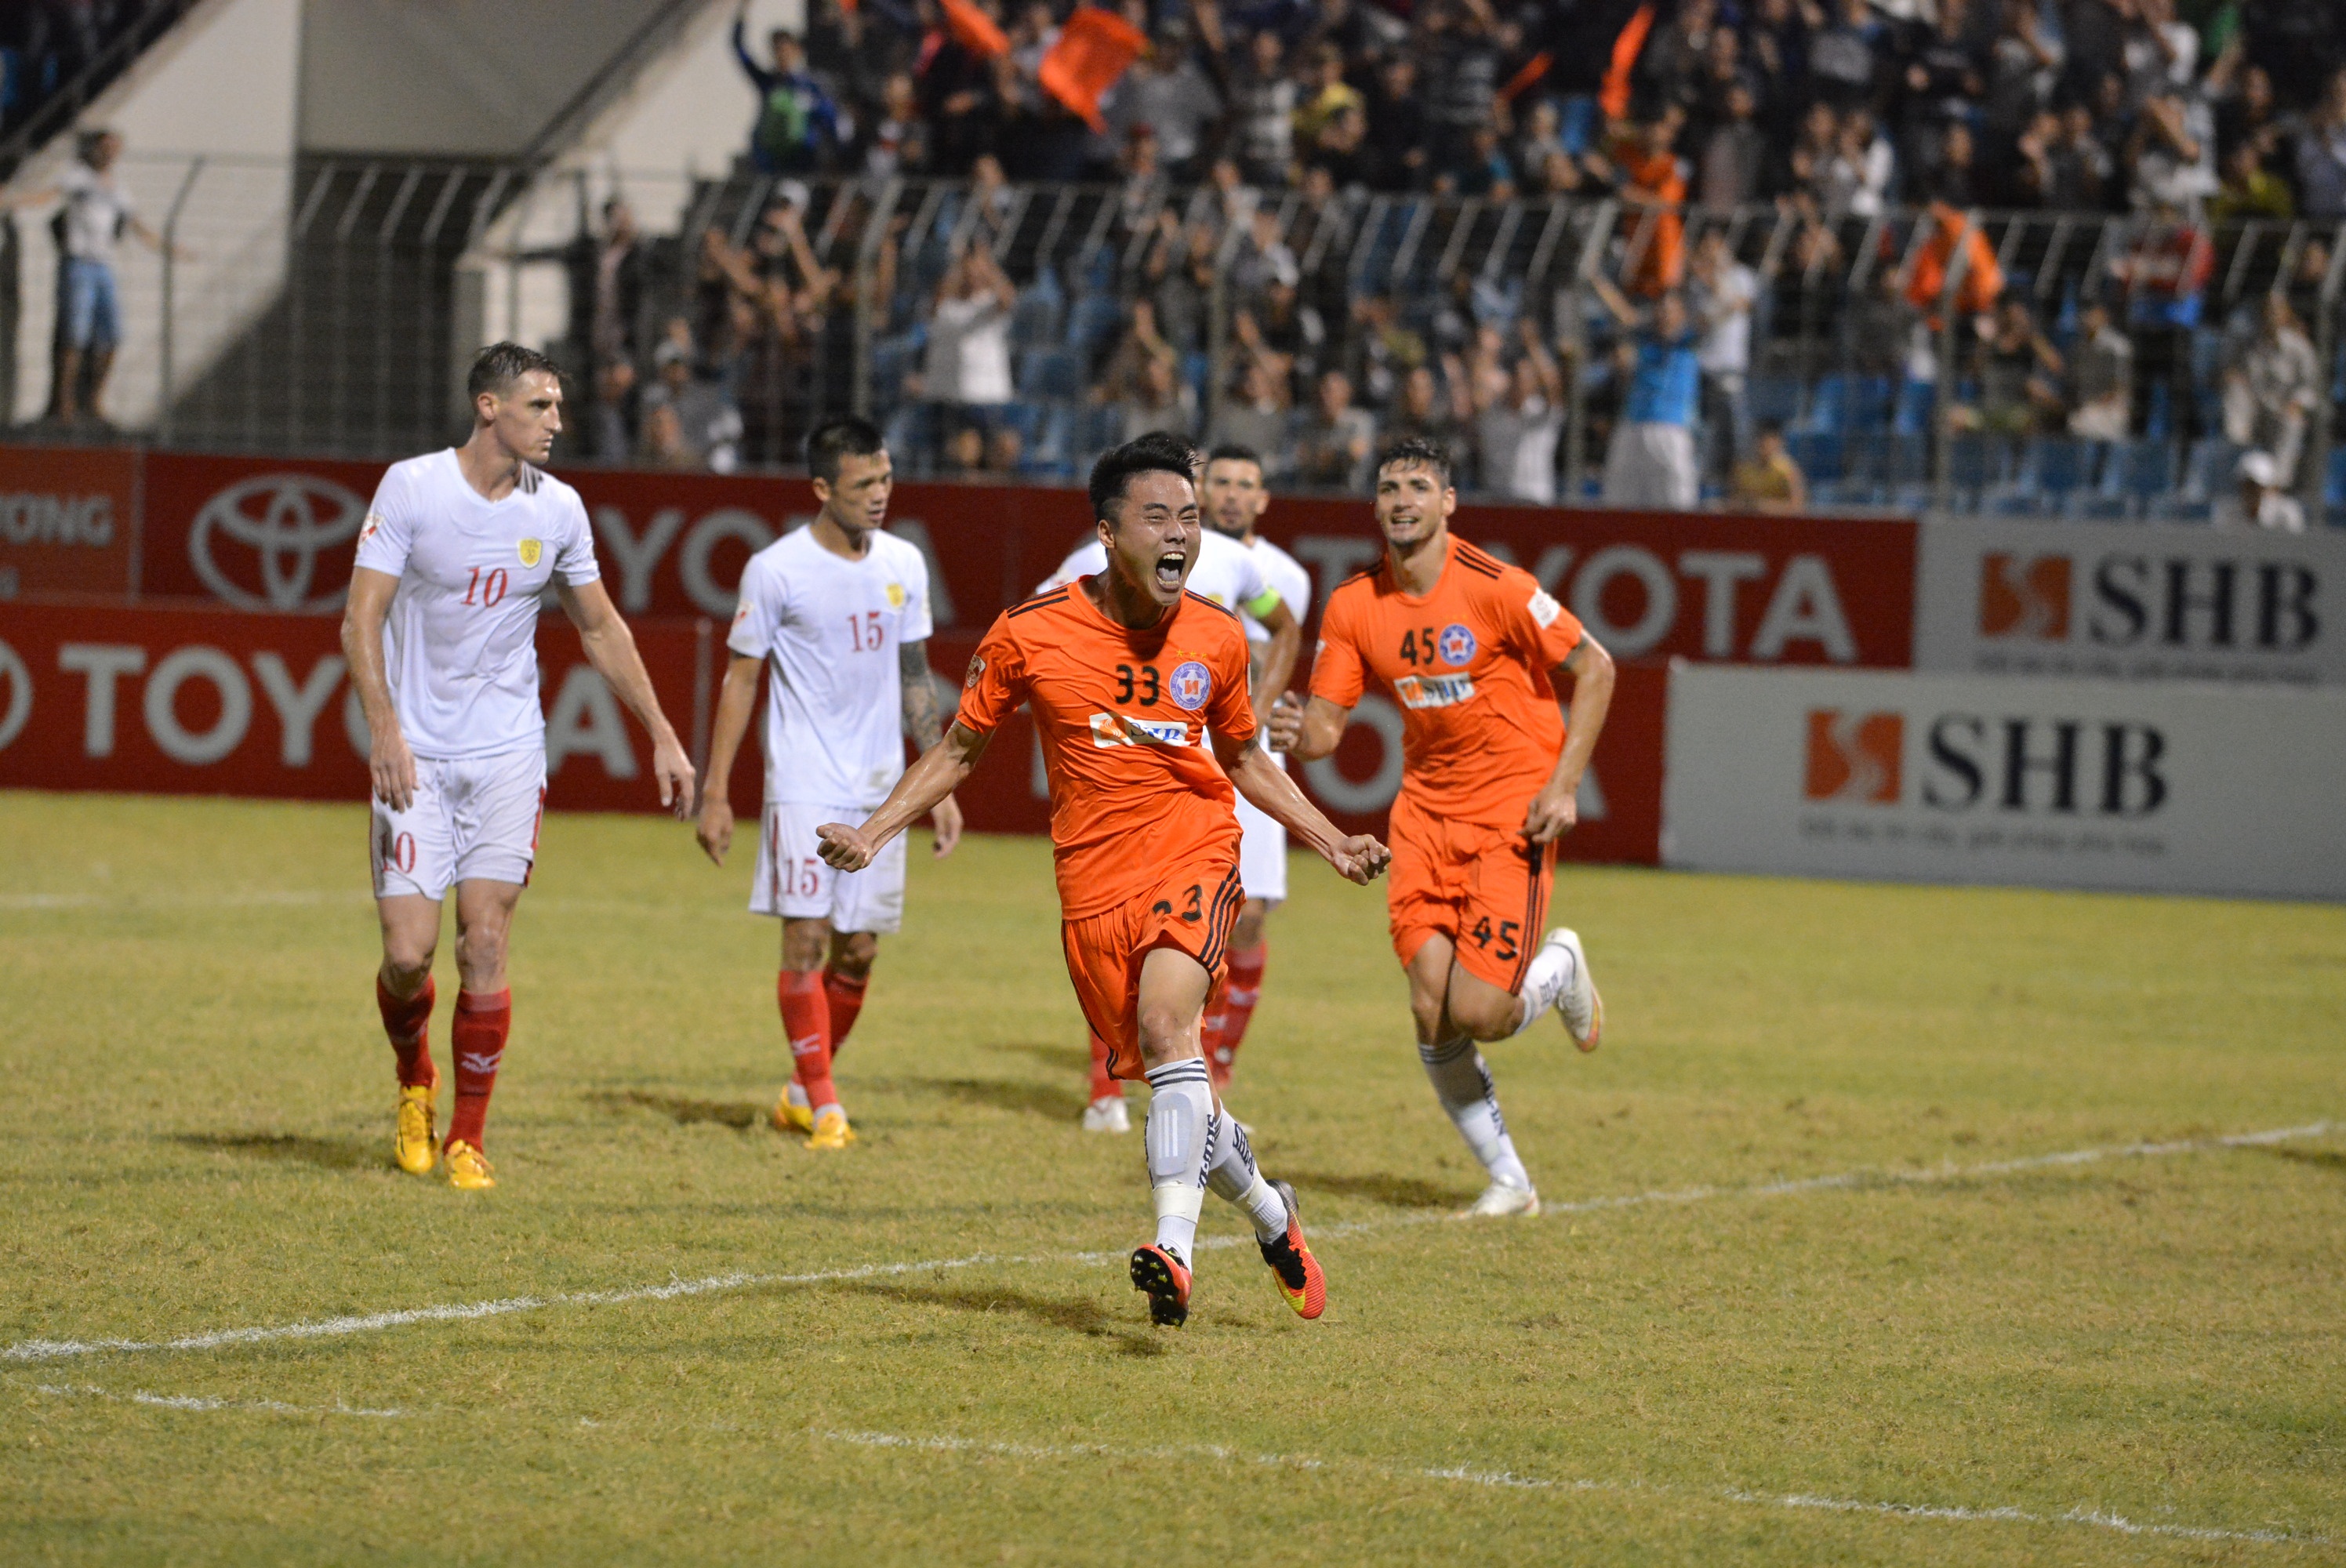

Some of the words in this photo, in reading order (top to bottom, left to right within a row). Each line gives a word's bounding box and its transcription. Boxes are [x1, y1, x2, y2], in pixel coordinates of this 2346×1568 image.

[460, 567, 508, 608] 10
[2087, 554, 2321, 652] SHB
[848, 611, 884, 653] 15
[1400, 627, 1435, 666] 45
[1115, 663, 1160, 707] 33
[57, 644, 638, 779] TOYA
[1921, 711, 2170, 818] SHB
[380, 831, 416, 873] 10
[786, 858, 818, 896] 15
[1472, 916, 1520, 961] 45
